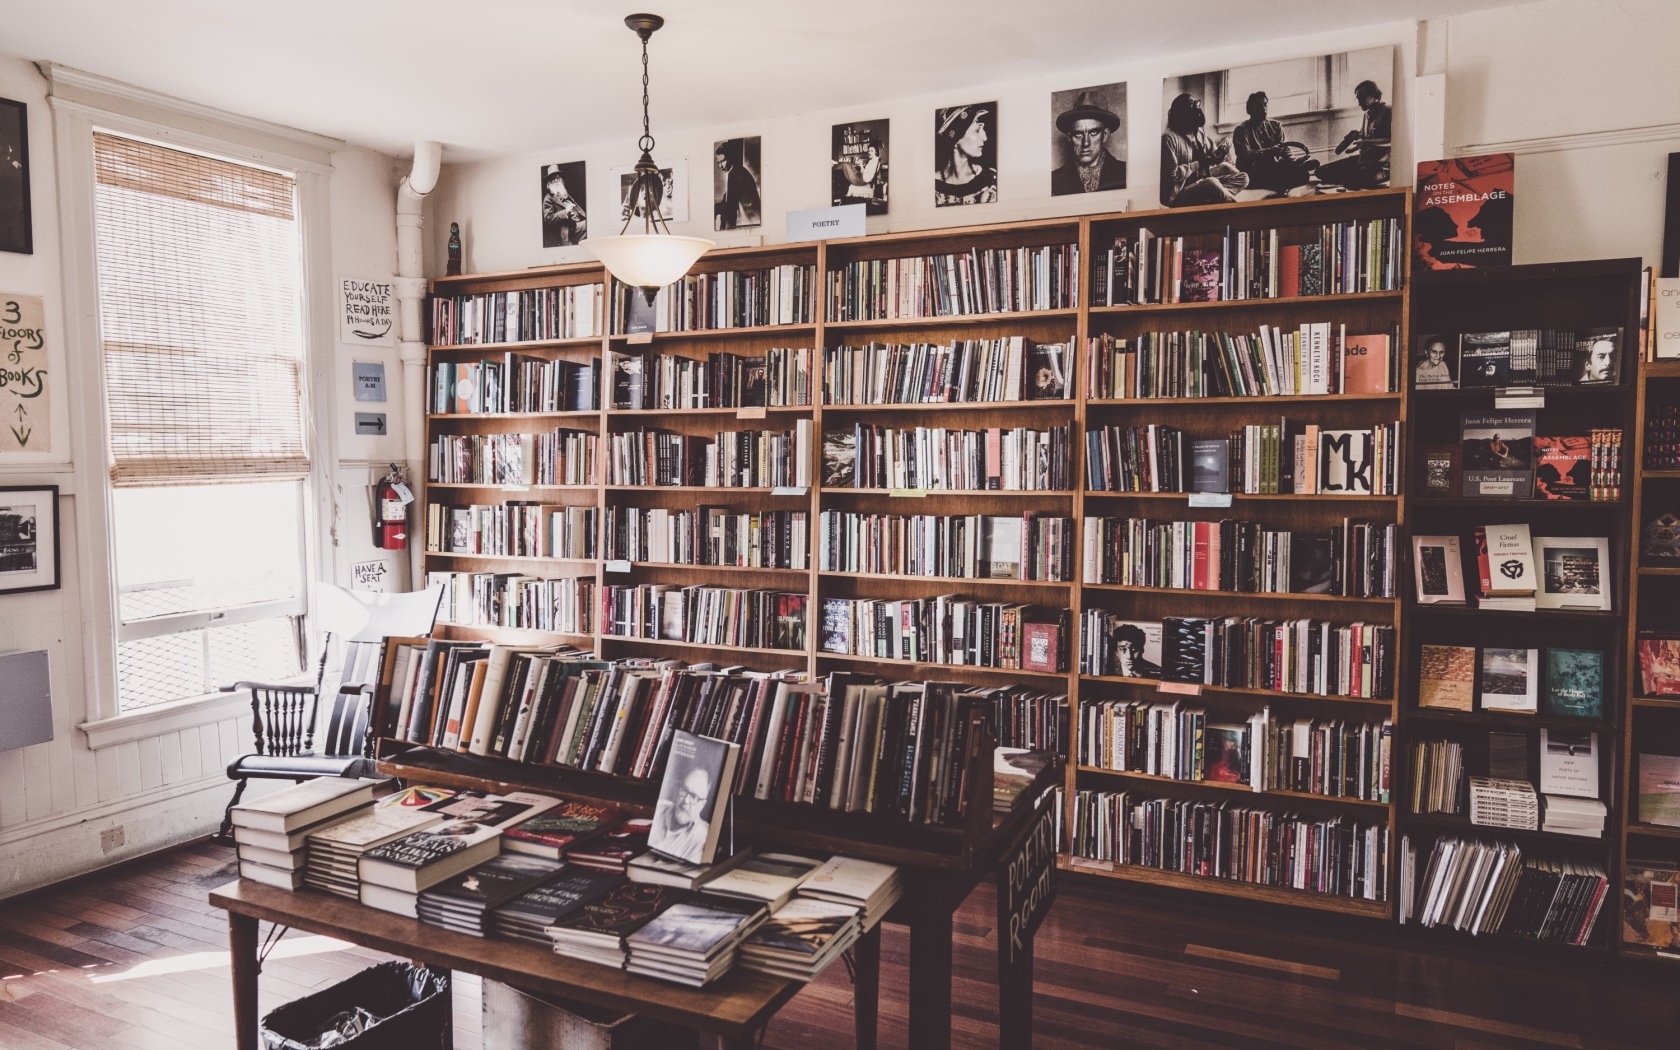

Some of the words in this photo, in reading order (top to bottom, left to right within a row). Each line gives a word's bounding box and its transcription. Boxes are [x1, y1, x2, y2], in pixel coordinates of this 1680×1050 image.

[1424, 183, 1455, 191] NOTES
[1426, 191, 1506, 205] ASSEMBLAGE
[812, 220, 840, 228] POETRY
[344, 280, 391, 297] EDUCATE
[1662, 289, 1680, 297] an
[344, 291, 388, 304] YOURSELF
[2, 301, 21, 324] 3
[346, 304, 370, 315] READ
[372, 305, 391, 317] HERE
[8, 340, 24, 364] of
[1482, 417, 1503, 425] Felipe
[355, 562, 377, 578] HAVE
[378, 562, 387, 573] A
[360, 572, 382, 584] SEAT
[905, 744, 914, 770] BRIGHT
[1008, 799, 1055, 910] POETRY
[555, 890, 583, 900] FINAL
